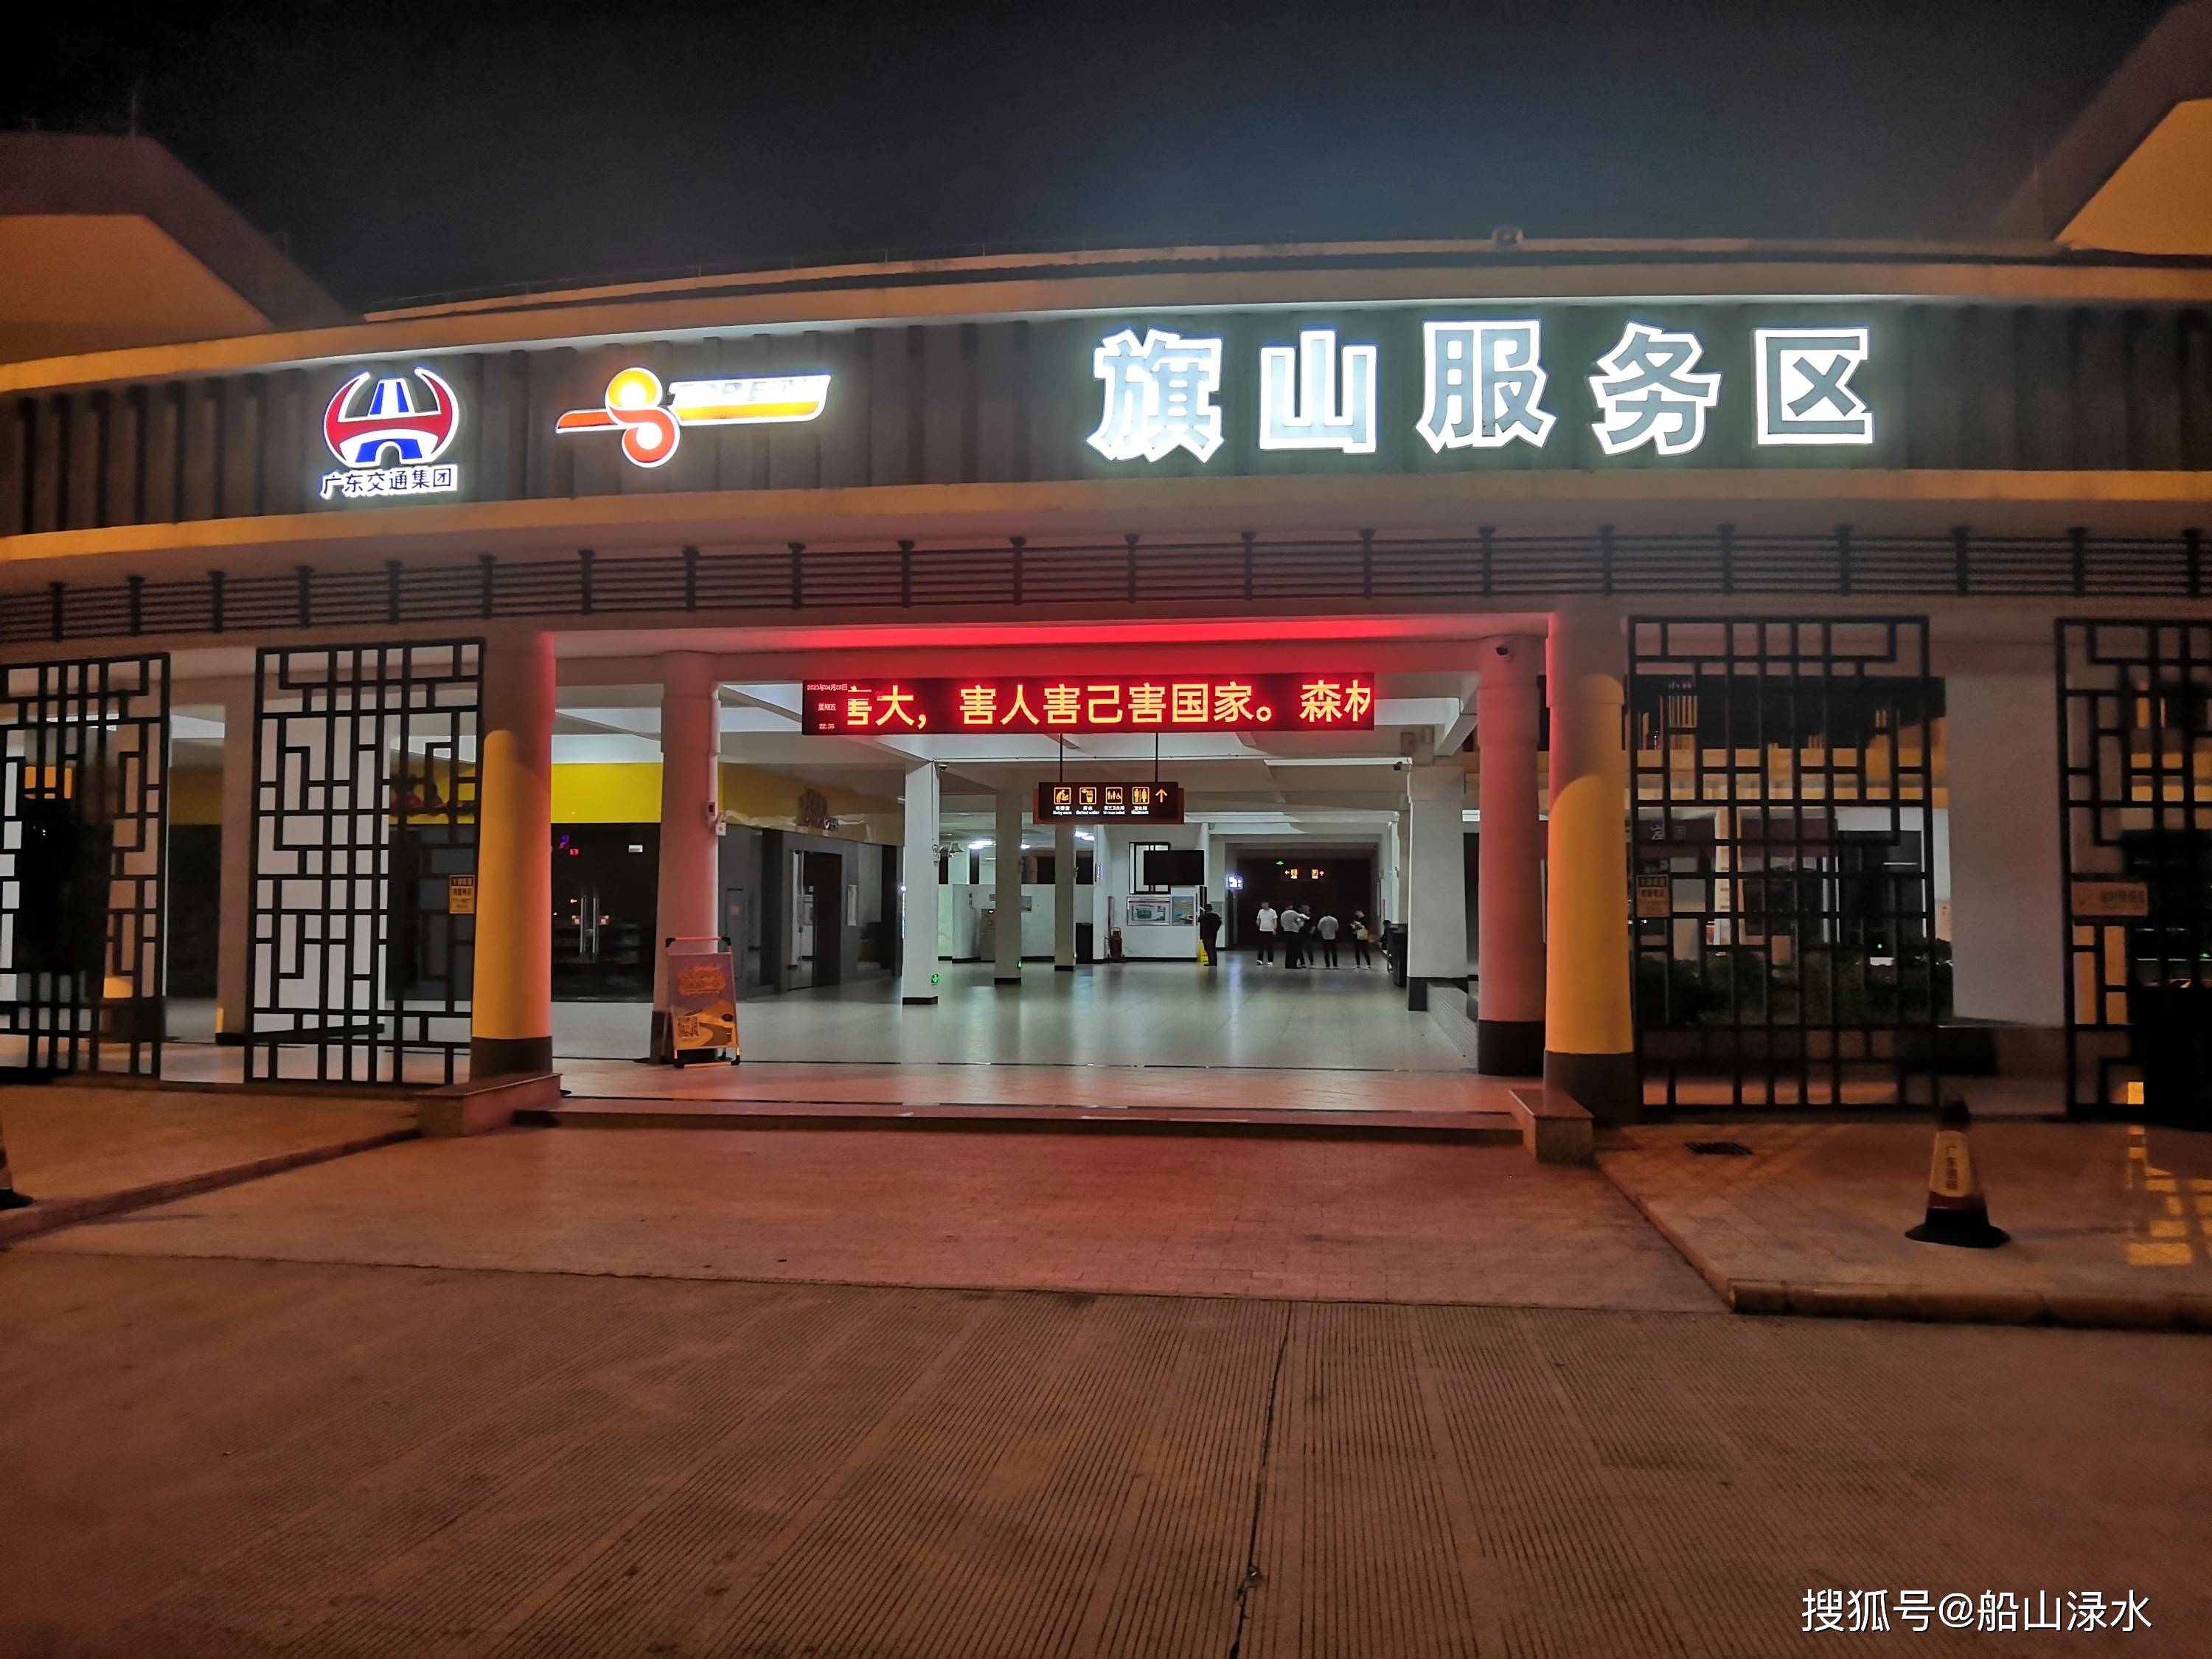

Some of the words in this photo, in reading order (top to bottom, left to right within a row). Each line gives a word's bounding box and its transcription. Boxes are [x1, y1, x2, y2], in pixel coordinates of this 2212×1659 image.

[1087, 320, 1874, 463] 旗山服务区
[321, 467, 453, 497] 广东交通集团
